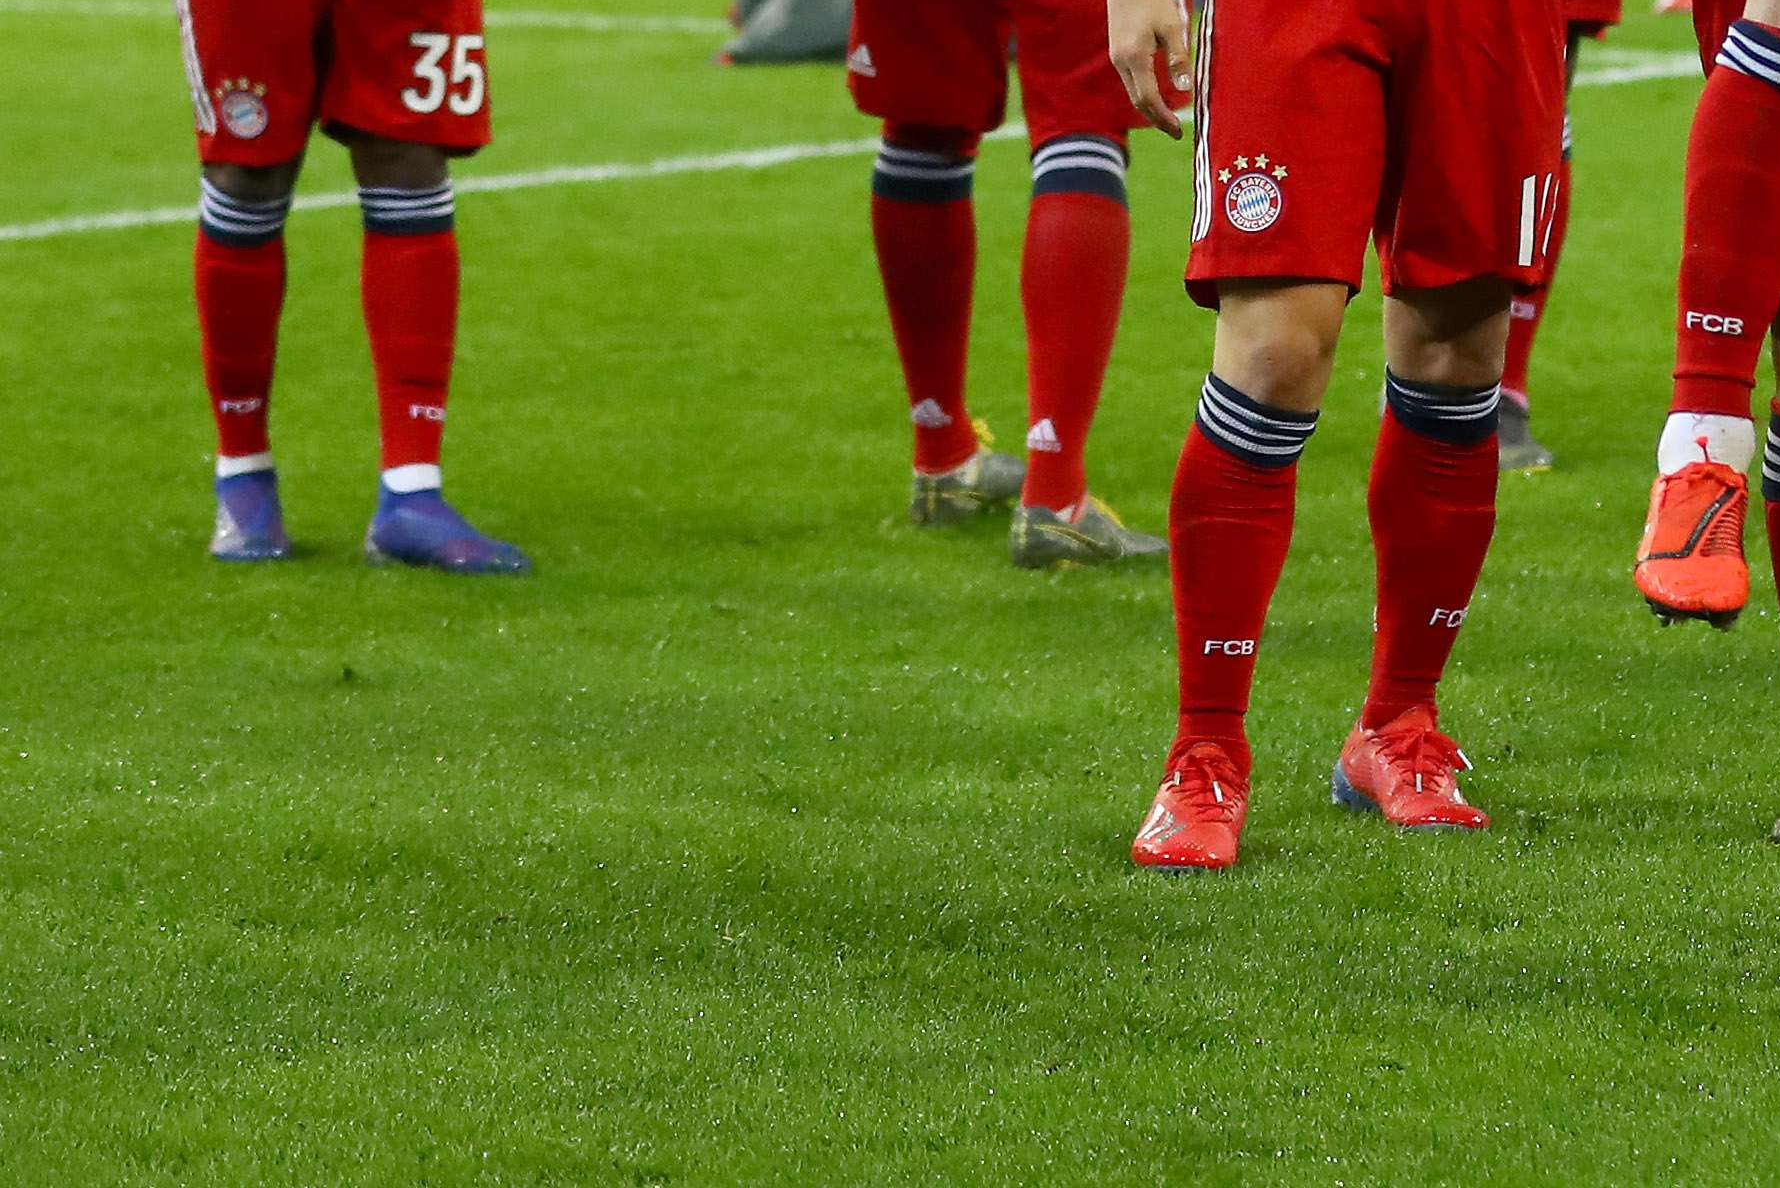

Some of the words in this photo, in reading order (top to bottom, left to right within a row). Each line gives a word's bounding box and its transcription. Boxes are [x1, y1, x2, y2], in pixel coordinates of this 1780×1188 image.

[401, 31, 485, 116] 35
[1686, 311, 1745, 336] FCB
[1204, 639, 1255, 656] FCB
